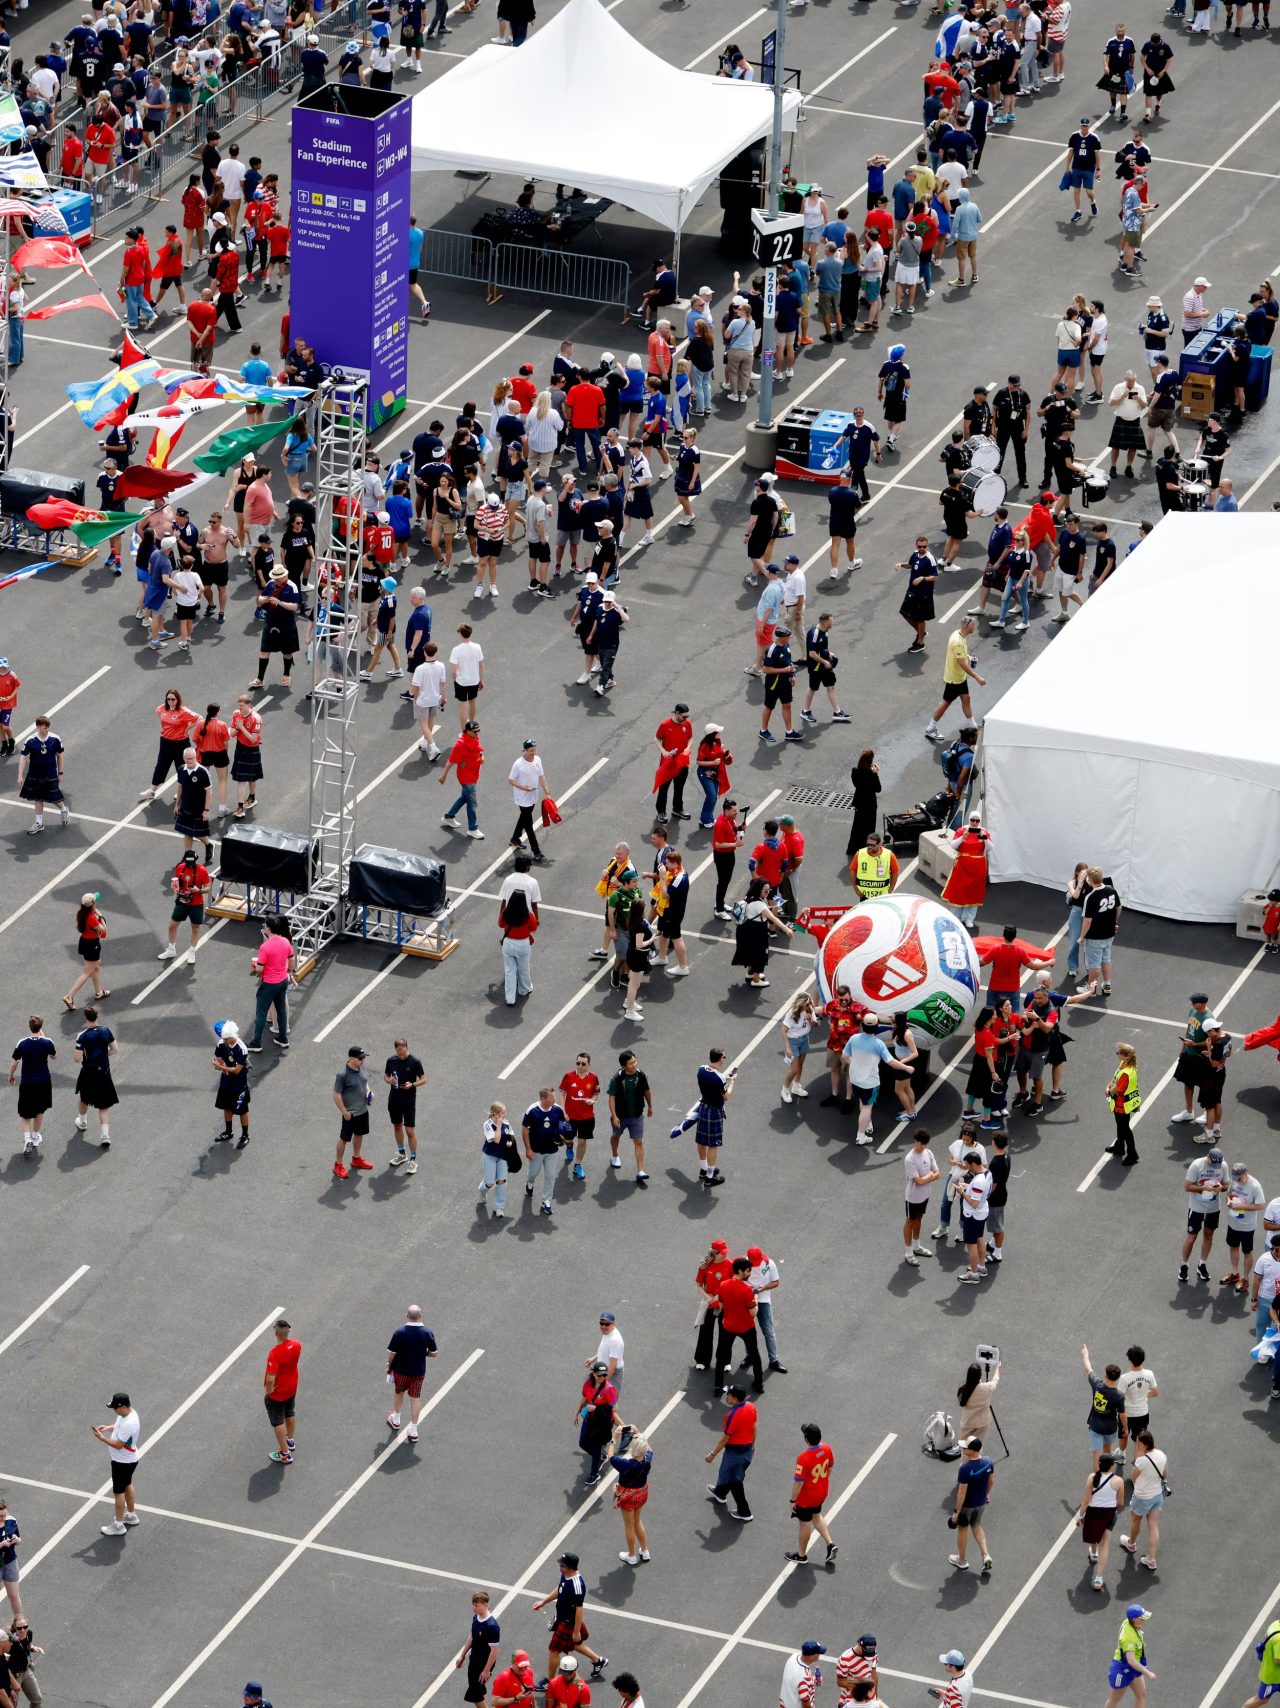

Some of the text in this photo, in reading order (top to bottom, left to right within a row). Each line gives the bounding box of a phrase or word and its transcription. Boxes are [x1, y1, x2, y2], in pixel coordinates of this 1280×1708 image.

[86, 63, 94, 76] 8
[326, 117, 340, 126] FIFA
[312, 138, 352, 154] Stadium
[386, 132, 391, 146] H
[298, 149, 368, 170] Fan Experience
[386, 145, 408, 170] W3-W4
[298, 206, 310, 214] Lots
[342, 200, 350, 208] P2
[298, 217, 350, 232] Accessible Parking
[298, 228, 330, 240] VIP Parking
[298, 240, 326, 250] Rideshare
[772, 234, 793, 262] 22
[381, 536, 392, 550] 10
[4, 714, 8, 722] 7
[860, 880, 886, 888] SECURITY
[1098, 894, 1116, 912] 25
[936, 998, 960, 1021] TRIONDA
